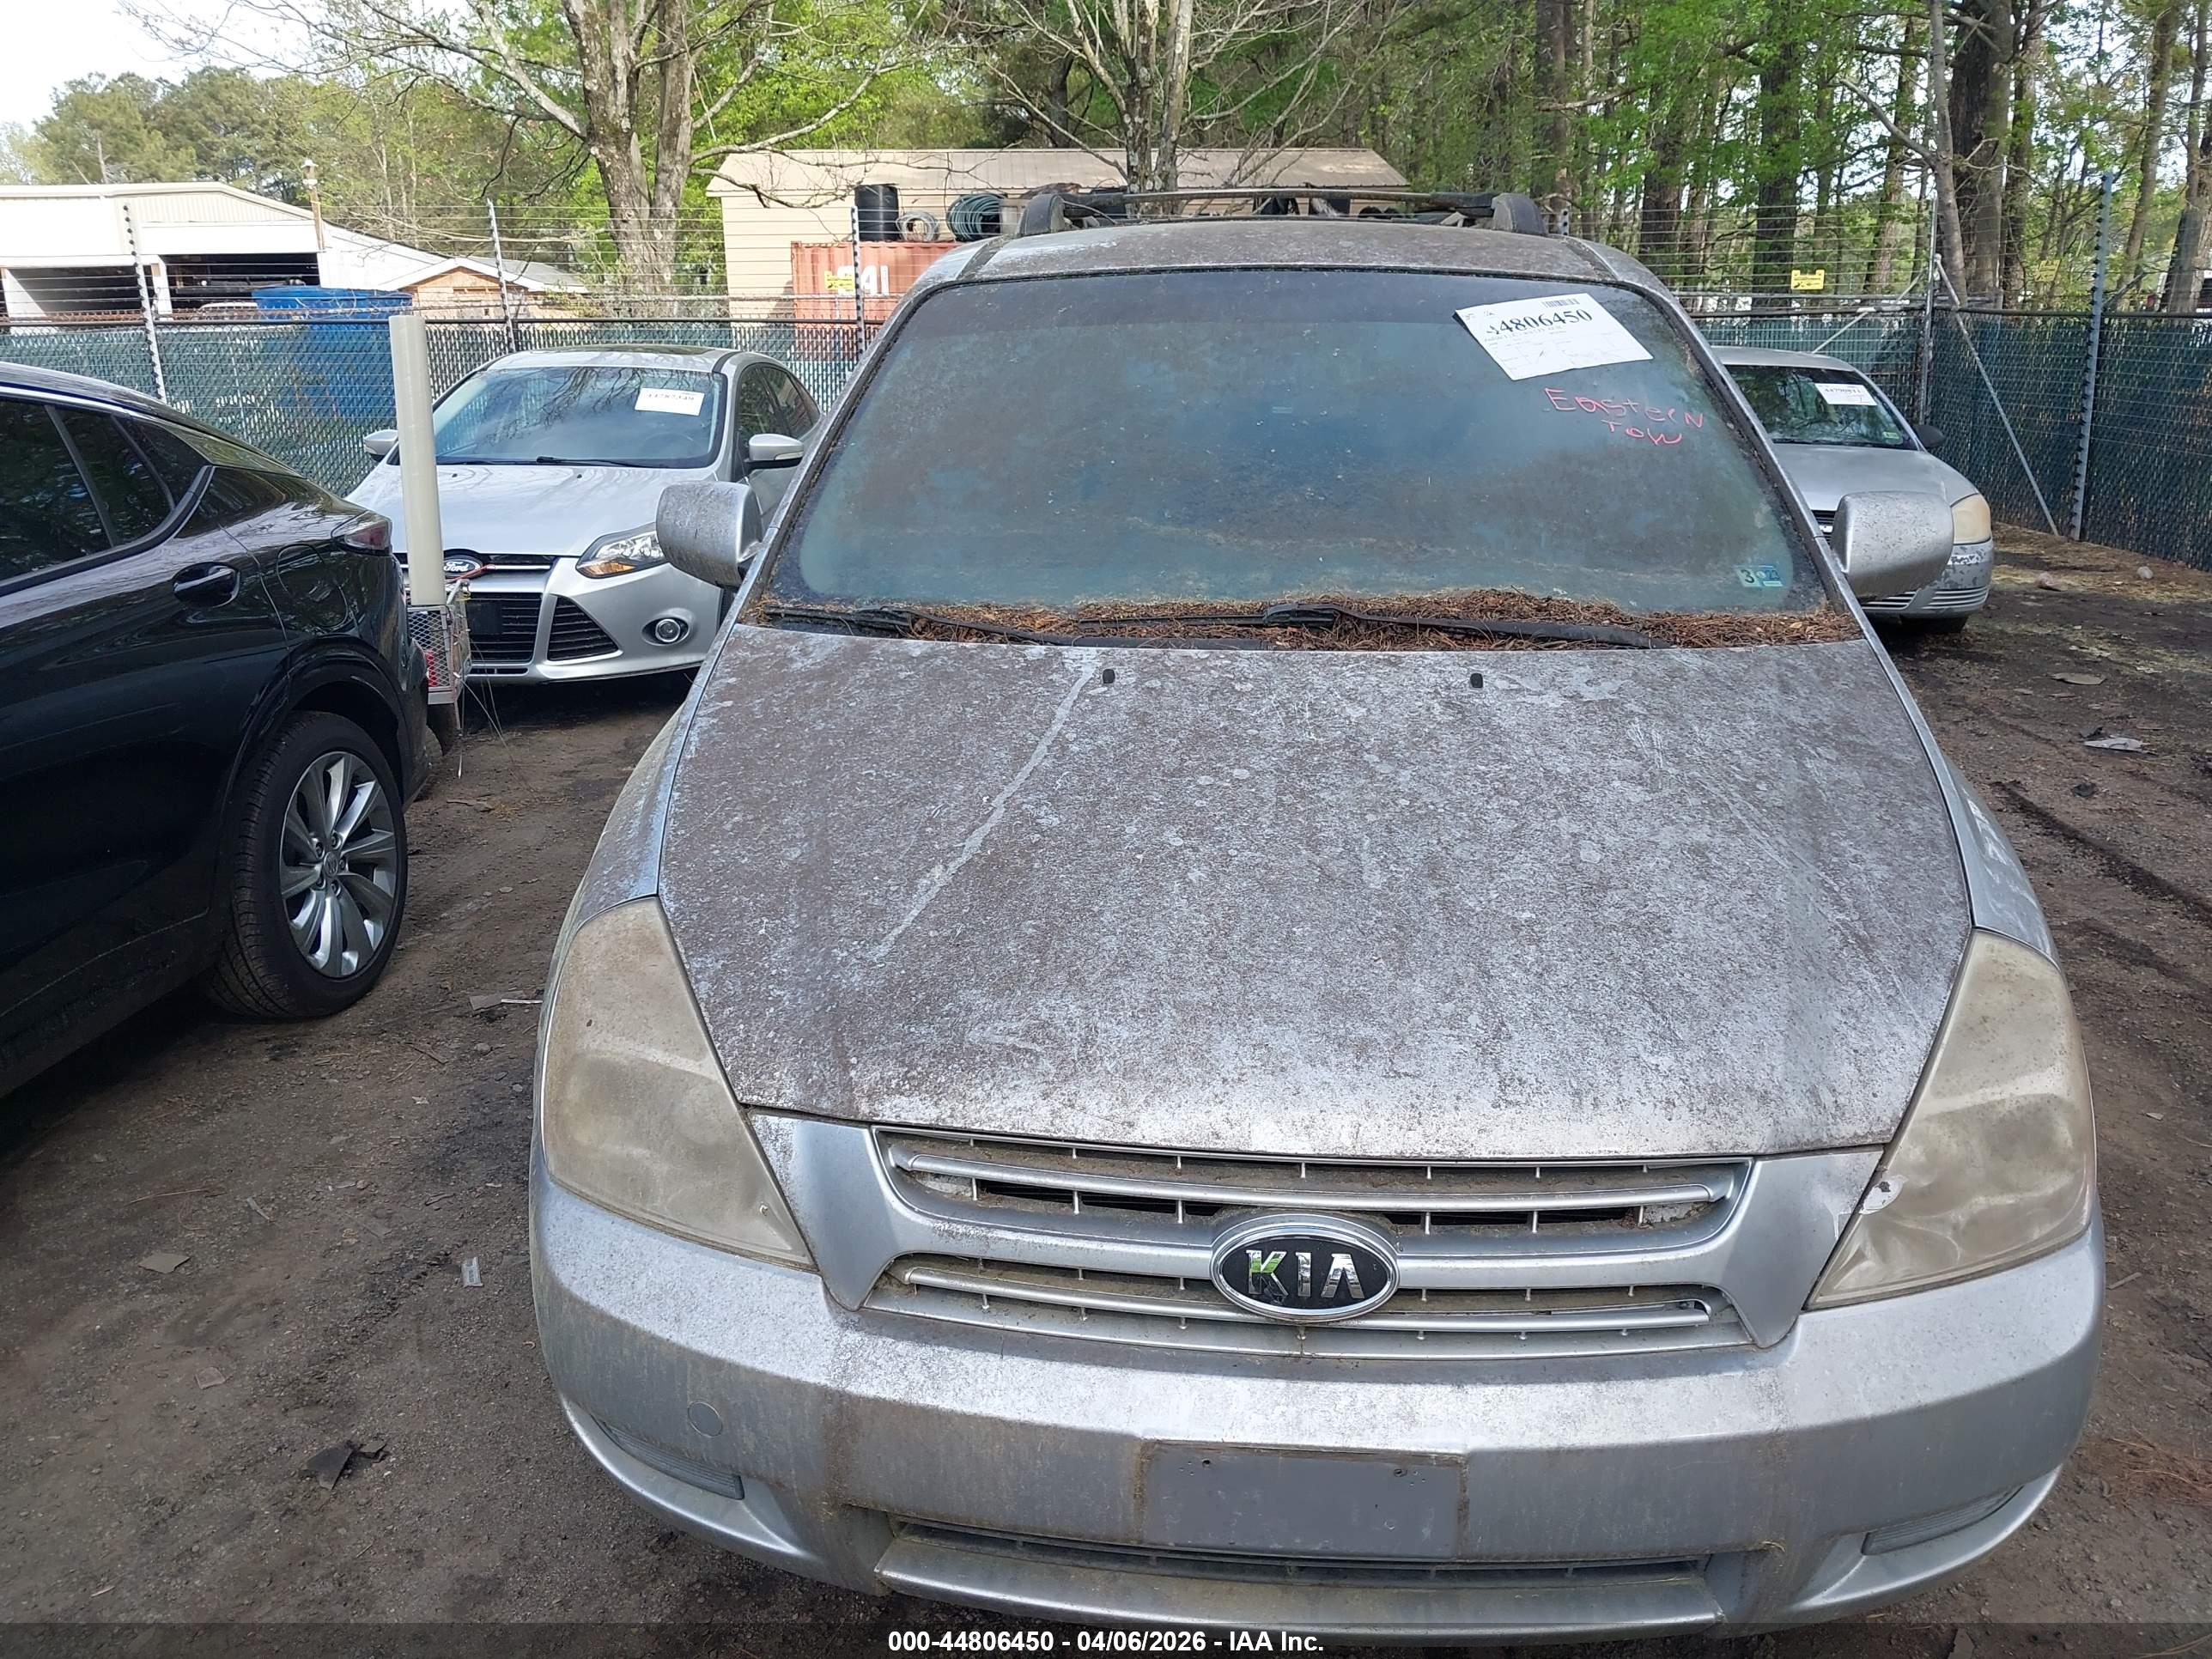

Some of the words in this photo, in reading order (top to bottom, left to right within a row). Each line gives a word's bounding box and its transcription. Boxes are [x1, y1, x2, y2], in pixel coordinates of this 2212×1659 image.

[443, 561, 470, 573] Ford
[1740, 568, 1755, 584] 3
[1246, 1249, 1365, 1299] KIA
